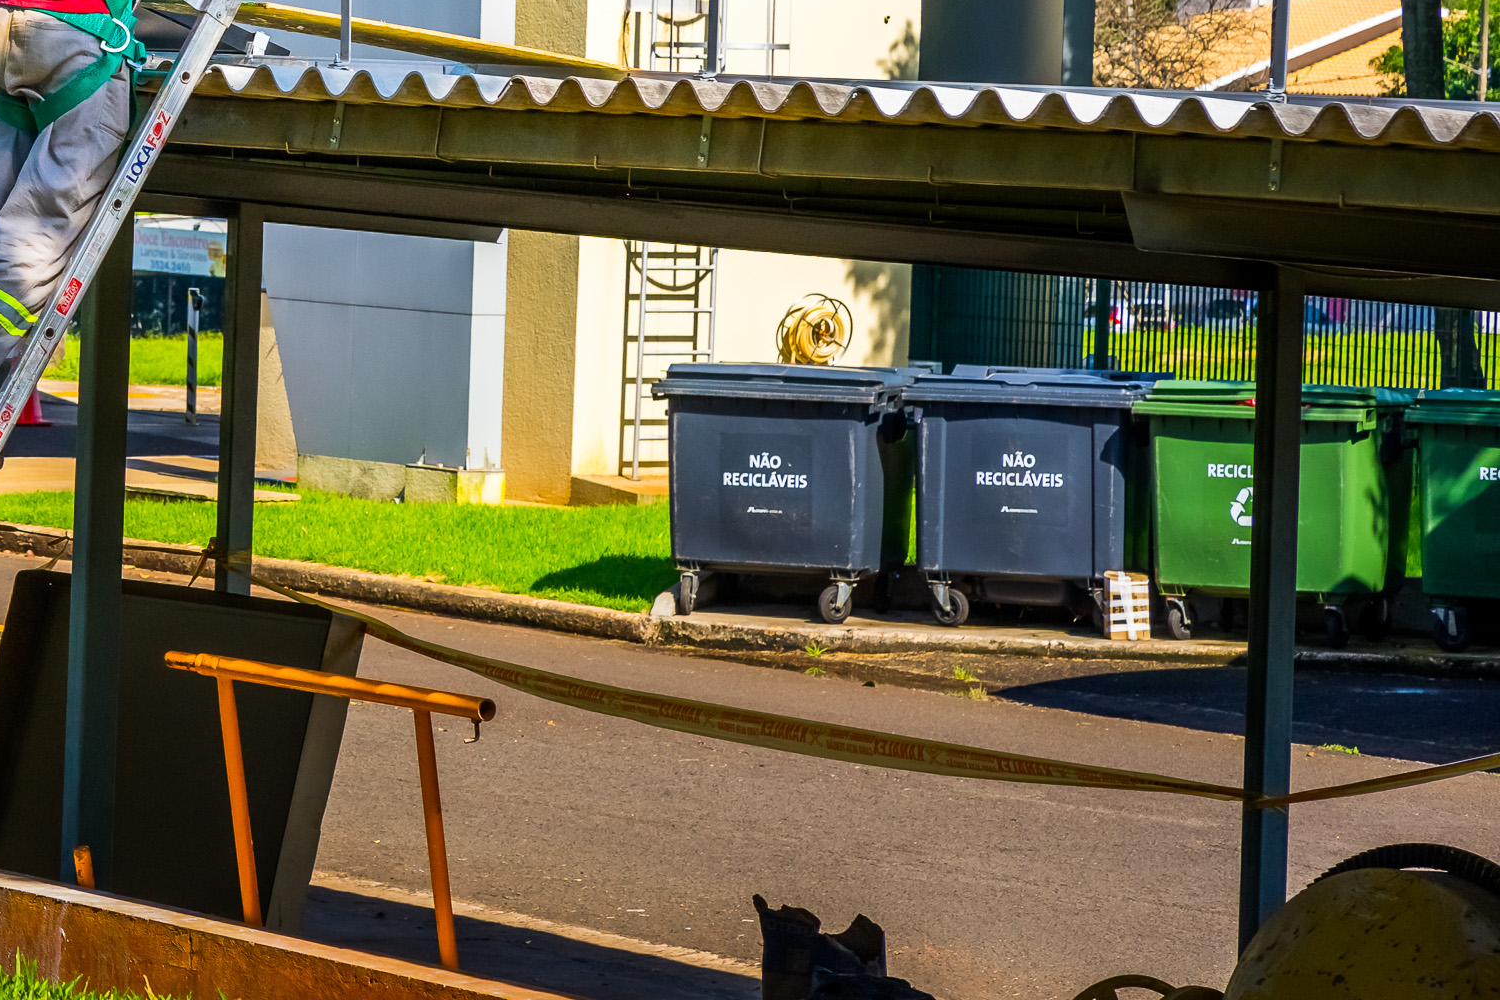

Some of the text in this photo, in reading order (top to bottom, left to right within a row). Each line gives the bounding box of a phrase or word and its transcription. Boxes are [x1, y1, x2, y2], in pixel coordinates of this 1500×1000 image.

[749, 451, 782, 469] NÃO
[1002, 450, 1036, 468] NÃO
[723, 471, 808, 489] RECICLÁVEIS
[976, 470, 1064, 488] RECICLÁVEIS
